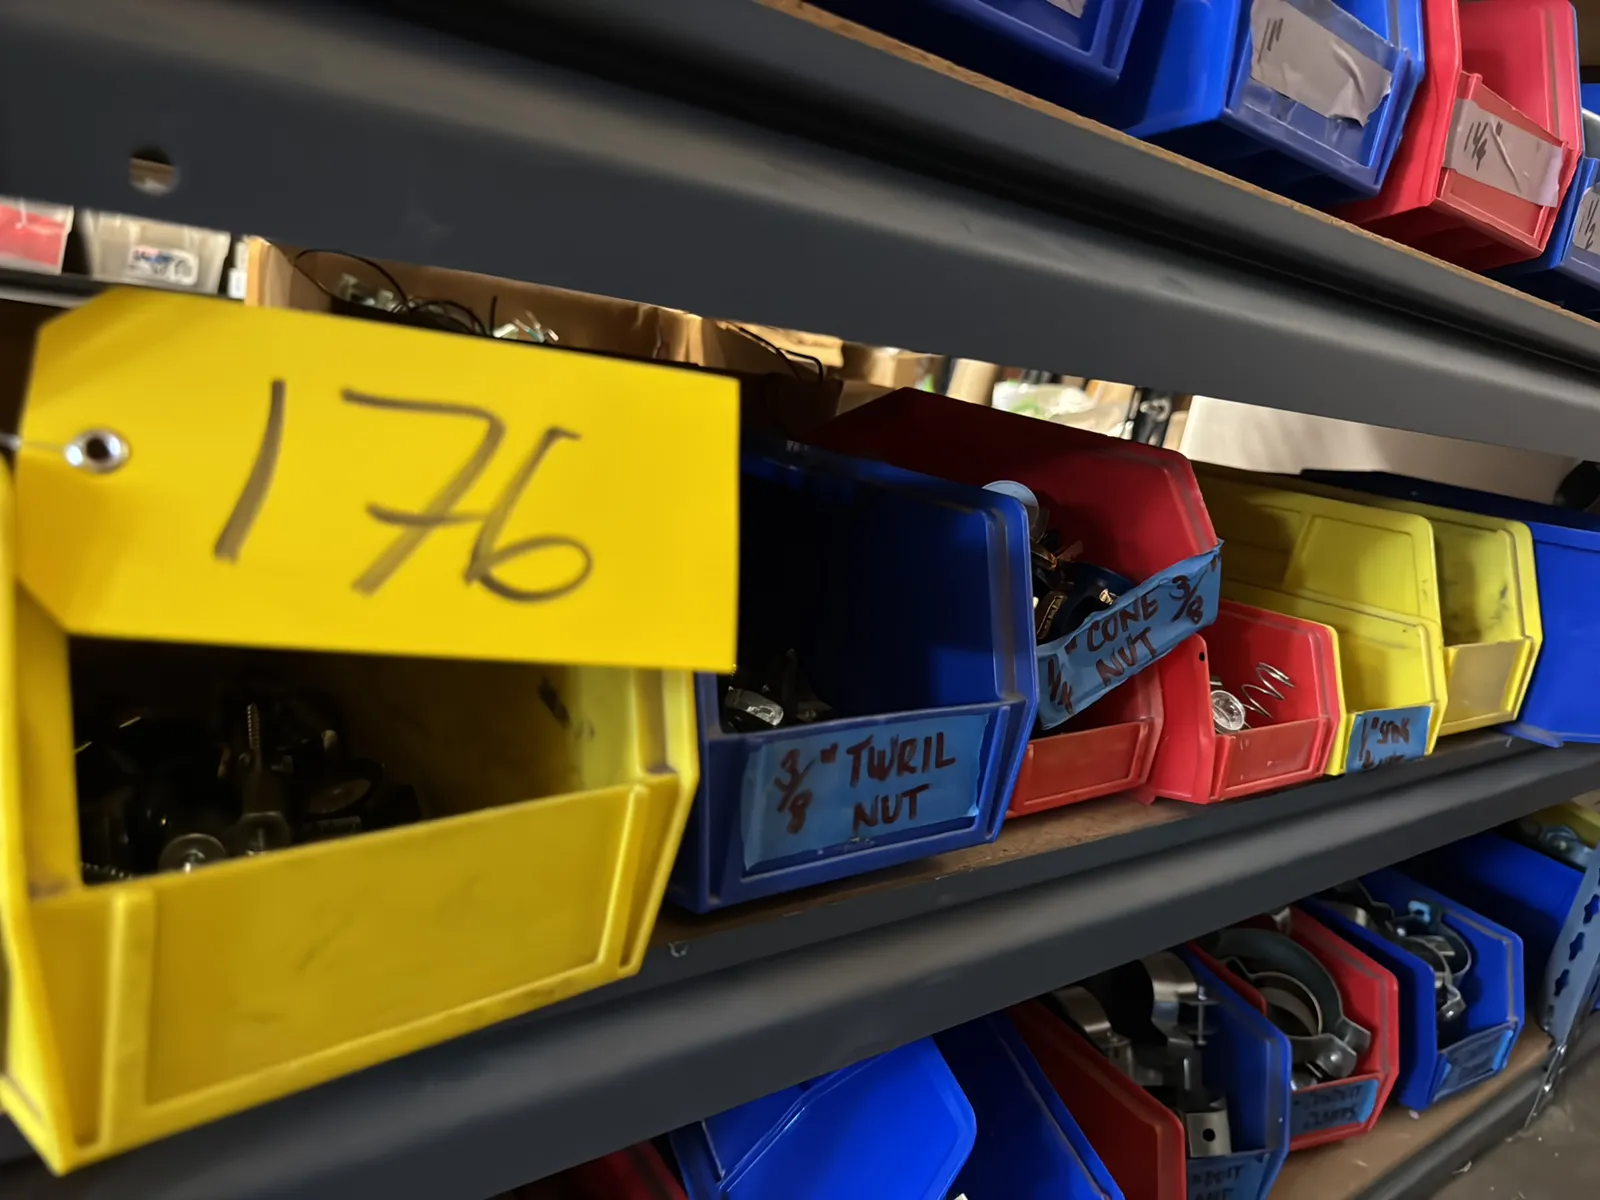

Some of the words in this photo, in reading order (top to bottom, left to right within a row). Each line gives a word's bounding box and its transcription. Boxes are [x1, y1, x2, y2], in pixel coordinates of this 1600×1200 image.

[213, 378, 592, 602] 176
[1085, 593, 1159, 652] CONE
[1095, 626, 1158, 687] NUT
[846, 731, 956, 787] TWRIL
[852, 783, 930, 832] NUT
